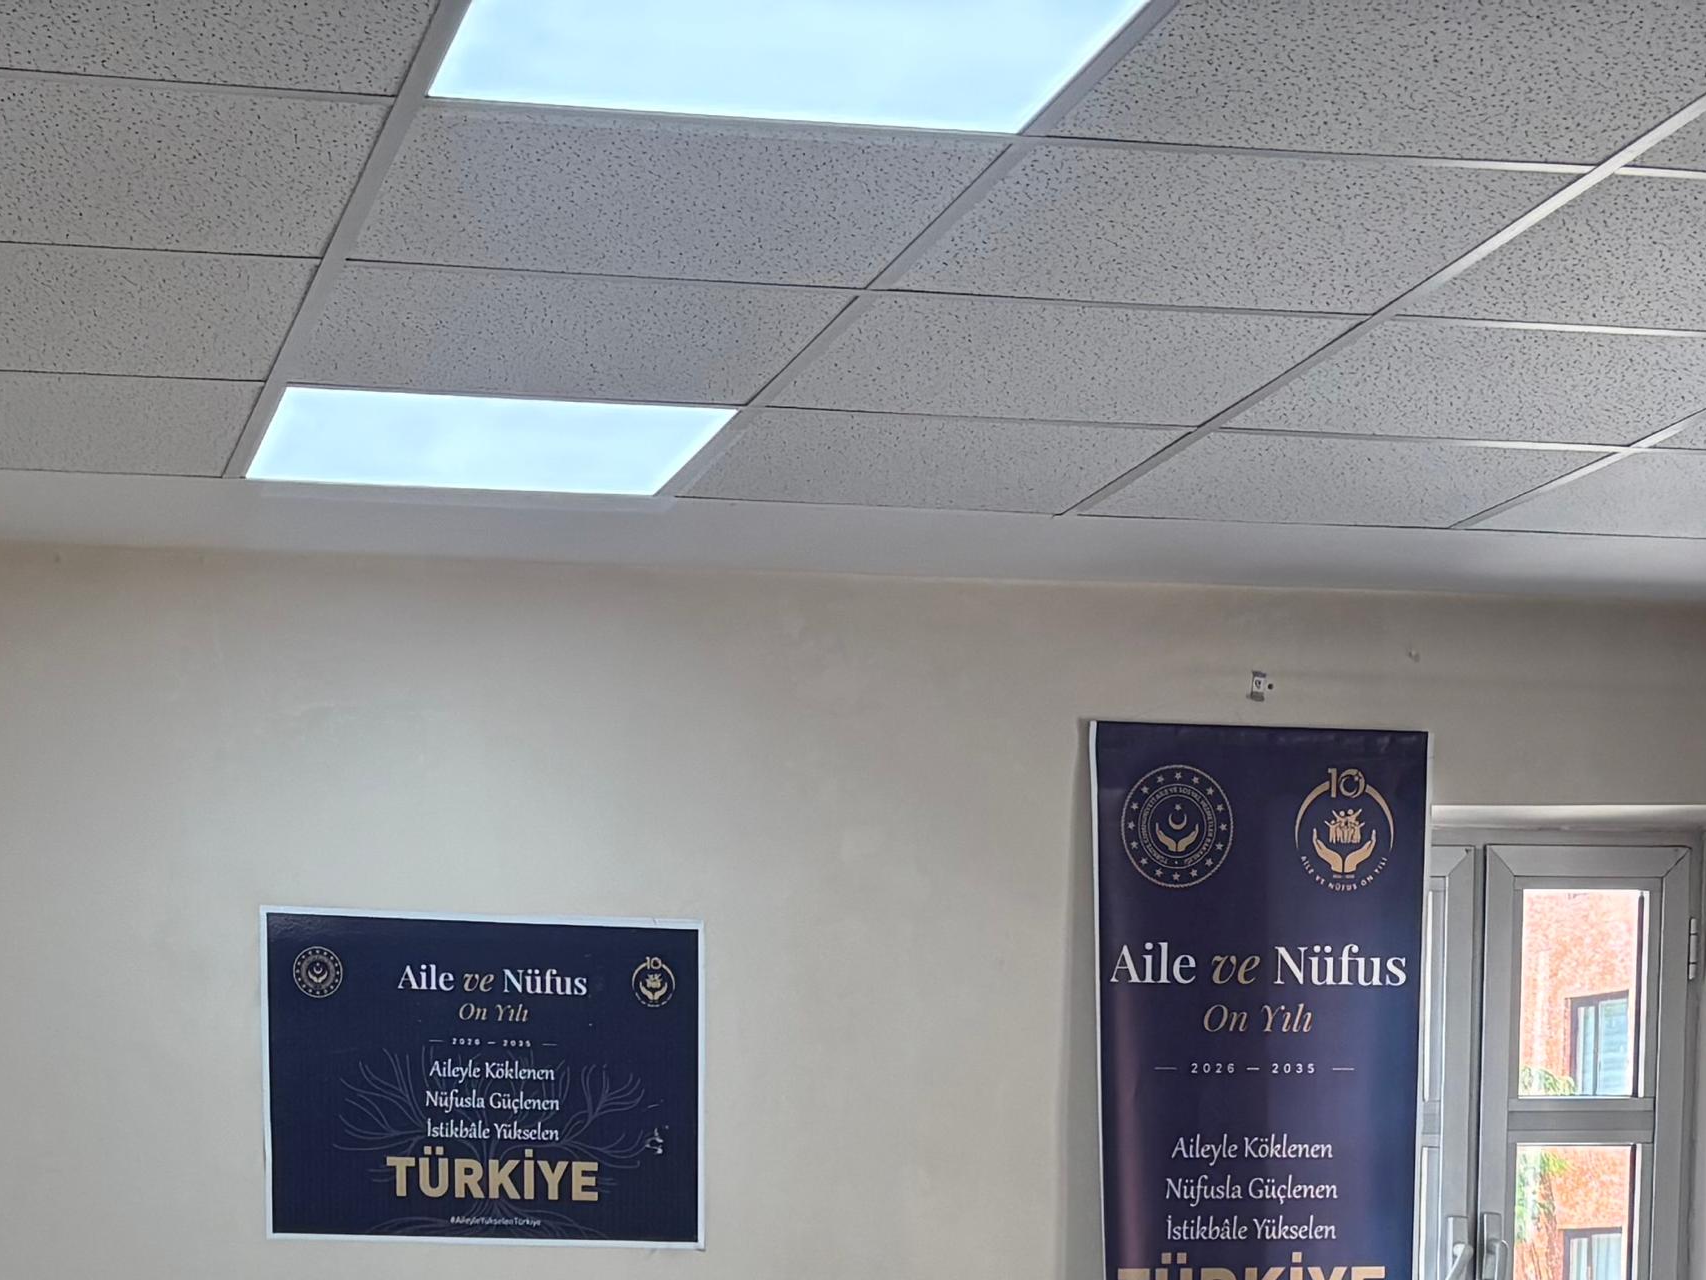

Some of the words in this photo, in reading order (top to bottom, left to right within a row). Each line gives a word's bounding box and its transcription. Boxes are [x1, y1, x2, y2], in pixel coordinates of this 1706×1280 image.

[1110, 941, 1196, 984] Aile
[1211, 952, 1261, 985] ve
[1273, 944, 1407, 986] Nüfus
[397, 965, 455, 992] Aile
[462, 971, 494, 993] ve
[502, 968, 588, 996] Nüfus
[459, 1003, 488, 1022] On
[494, 1003, 529, 1023] Yılı
[1203, 1004, 1248, 1033] On
[1261, 1002, 1314, 1033] Yılı
[429, 1060, 481, 1082] Aileyle
[484, 1061, 556, 1081] Köklenen
[1191, 1063, 1235, 1074] 2026
[1271, 1063, 1315, 1074] 2035
[425, 1089, 485, 1113] Nüfusla
[489, 1091, 560, 1115] Güçlenen
[426, 1119, 490, 1140] İstikbâle
[493, 1121, 560, 1142] Yükselen
[1171, 1133, 1238, 1166] Aileyle
[1243, 1134, 1334, 1159] Köklenen
[386, 1145, 599, 1202] TÜRKİYE
[1165, 1174, 1243, 1207] Nüfusla
[1248, 1174, 1338, 1205] Güçlenen
[1166, 1215, 1248, 1241] İstikbâle
[1253, 1216, 1337, 1240] Yükselen
